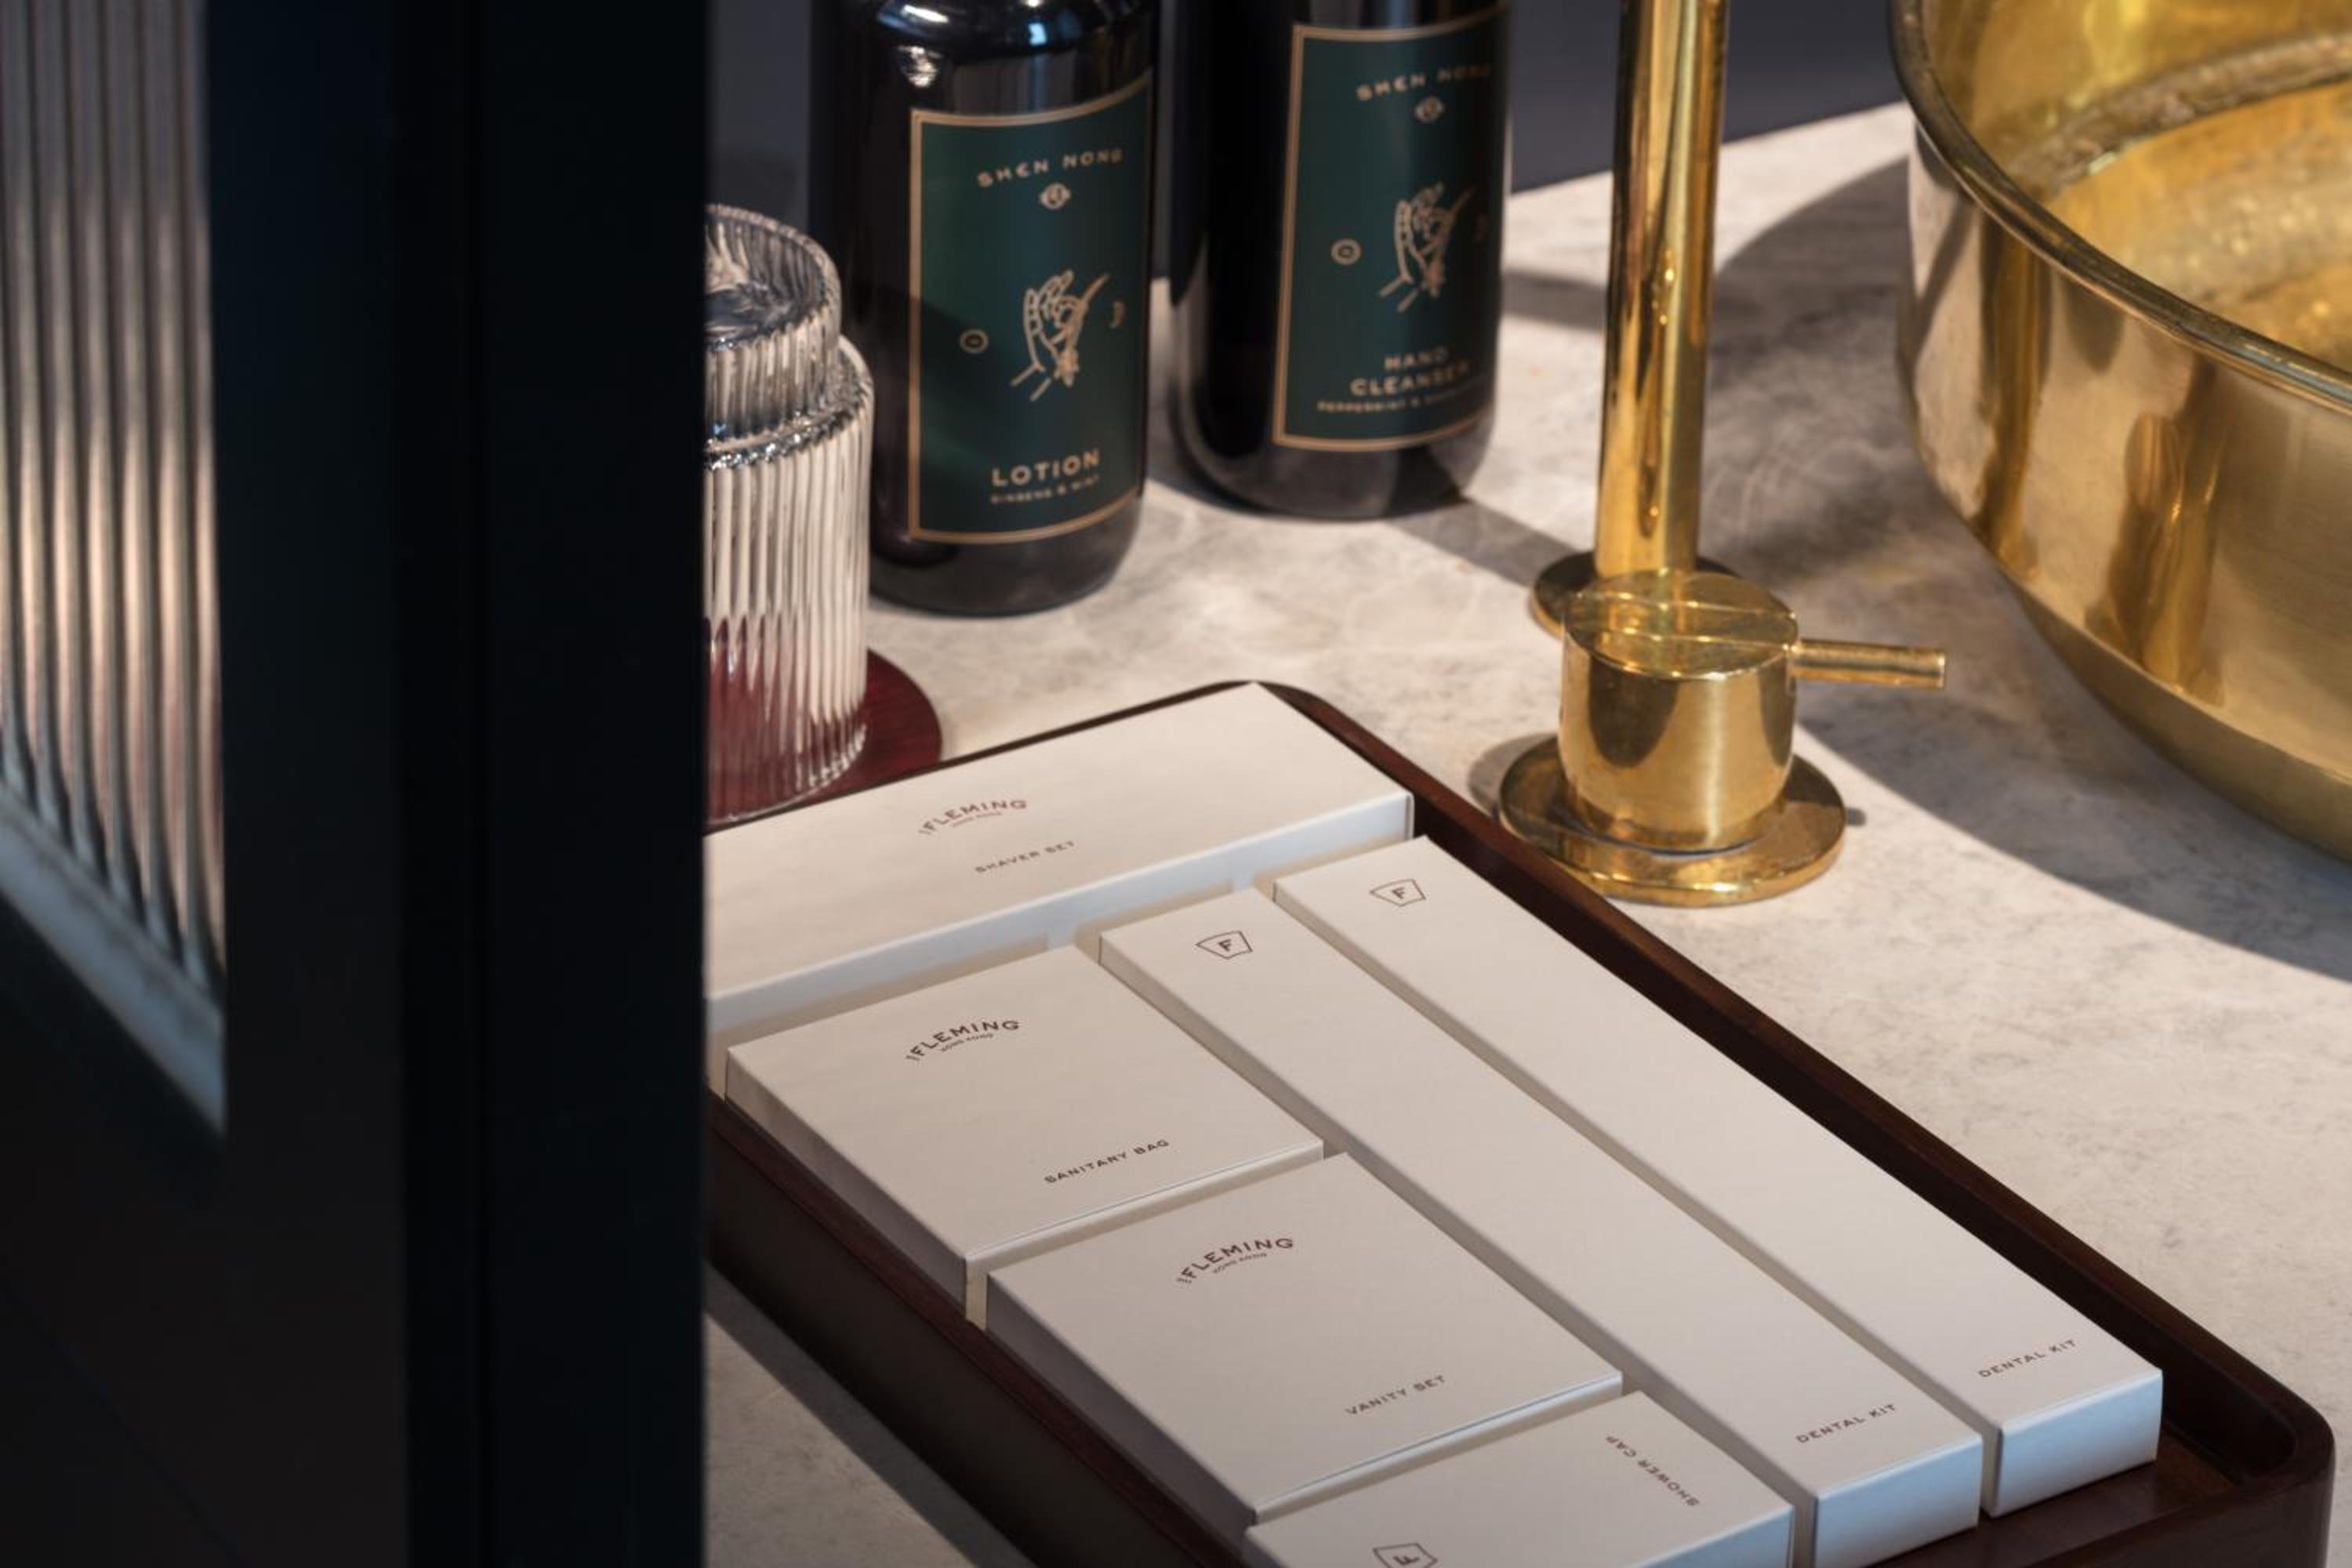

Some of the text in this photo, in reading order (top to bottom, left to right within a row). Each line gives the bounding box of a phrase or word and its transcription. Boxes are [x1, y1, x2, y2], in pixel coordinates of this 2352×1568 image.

[978, 159, 1049, 188] SHEN
[991, 448, 1100, 487] LOTION
[922, 800, 1027, 831] FLEMING
[975, 840, 1075, 873] SHAVER SET
[1391, 887, 1406, 899] F
[1218, 938, 1233, 952] F
[910, 1020, 1020, 1057] FLEMING
[1044, 1139, 1170, 1183] SANITARY BAG
[1181, 1238, 1294, 1279] FLEMING
[1977, 1339, 2076, 1377] DENTAL KIT
[1345, 1374, 1445, 1414] VANITY SET
[1795, 1404, 1896, 1443] DENTAL KIT
[1605, 1436, 1700, 1506] SHOWER CAP
[1392, 1555, 1420, 1566] F
